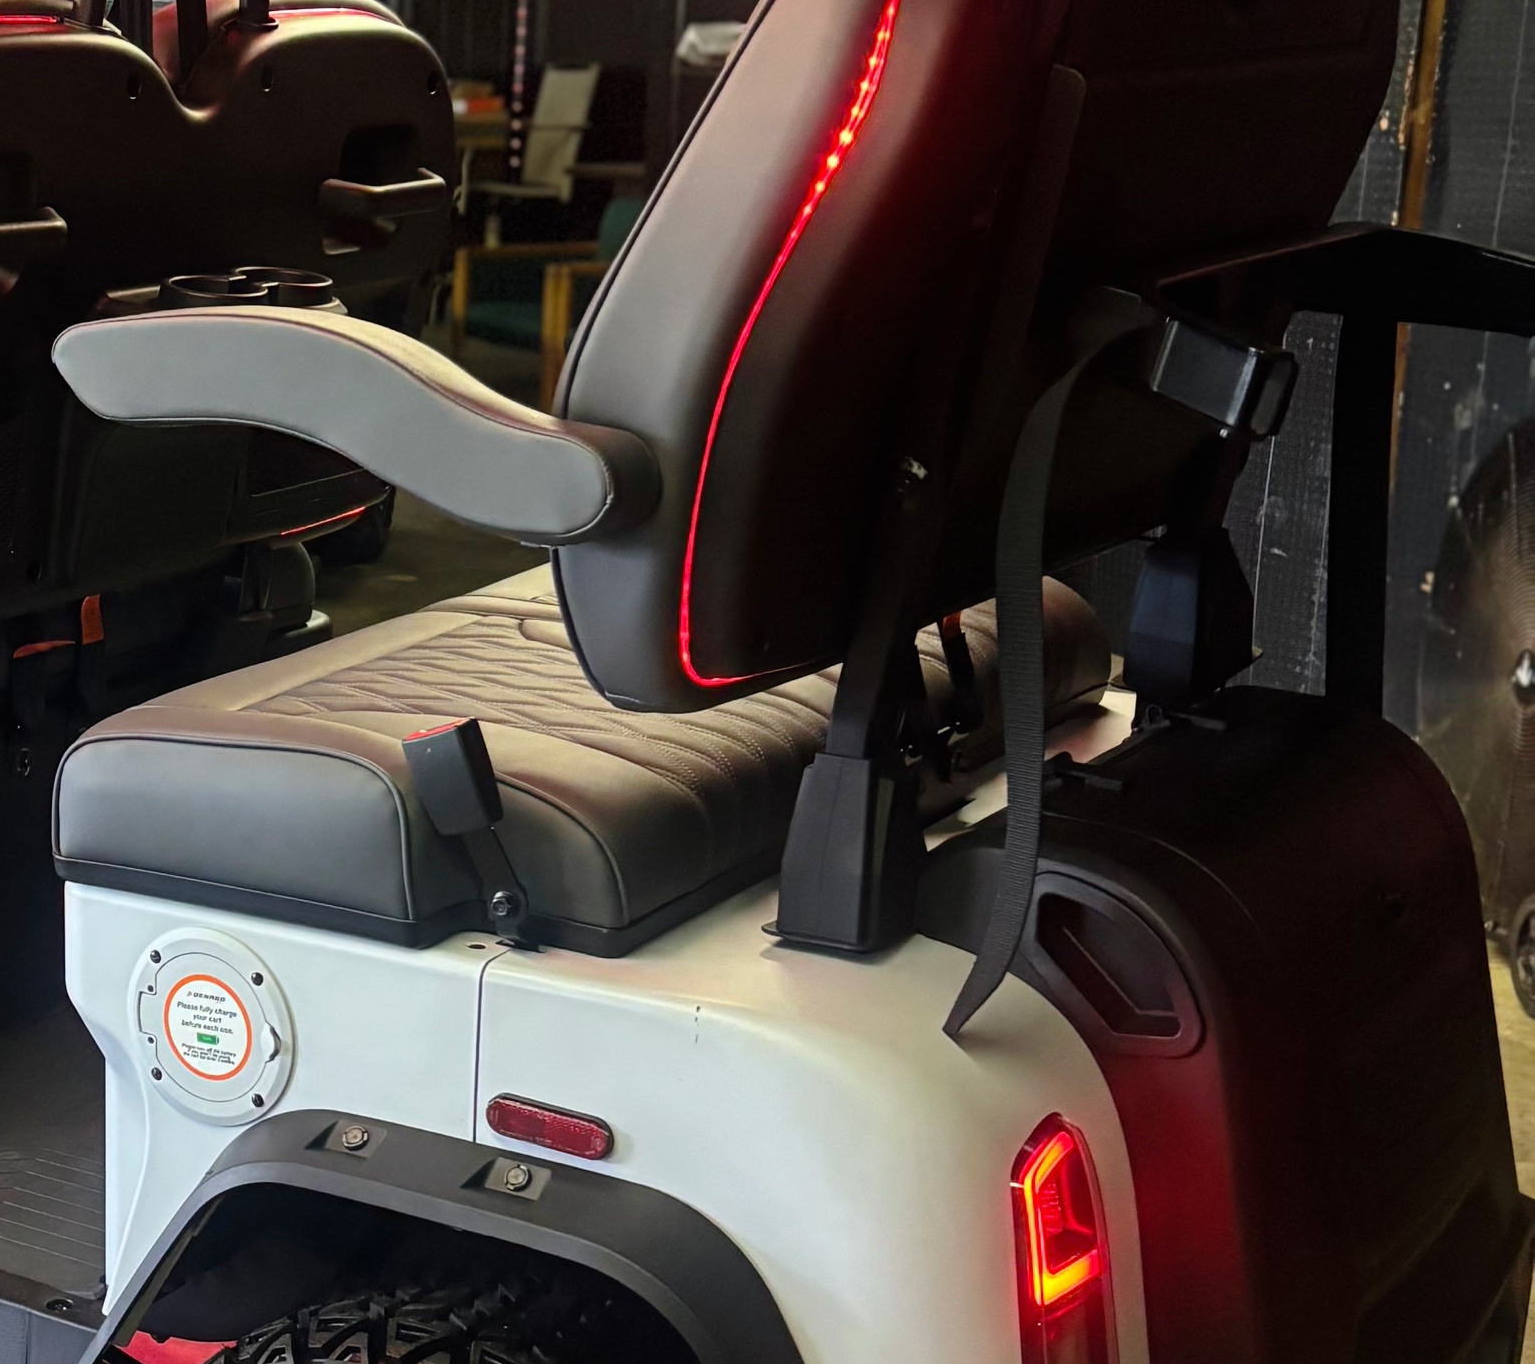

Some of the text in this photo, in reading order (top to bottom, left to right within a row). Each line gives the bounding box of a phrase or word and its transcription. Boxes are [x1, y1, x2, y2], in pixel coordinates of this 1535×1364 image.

[177, 1001, 237, 1019] Please fully charge
[181, 1019, 202, 1029] before
[203, 1024, 219, 1032] each
